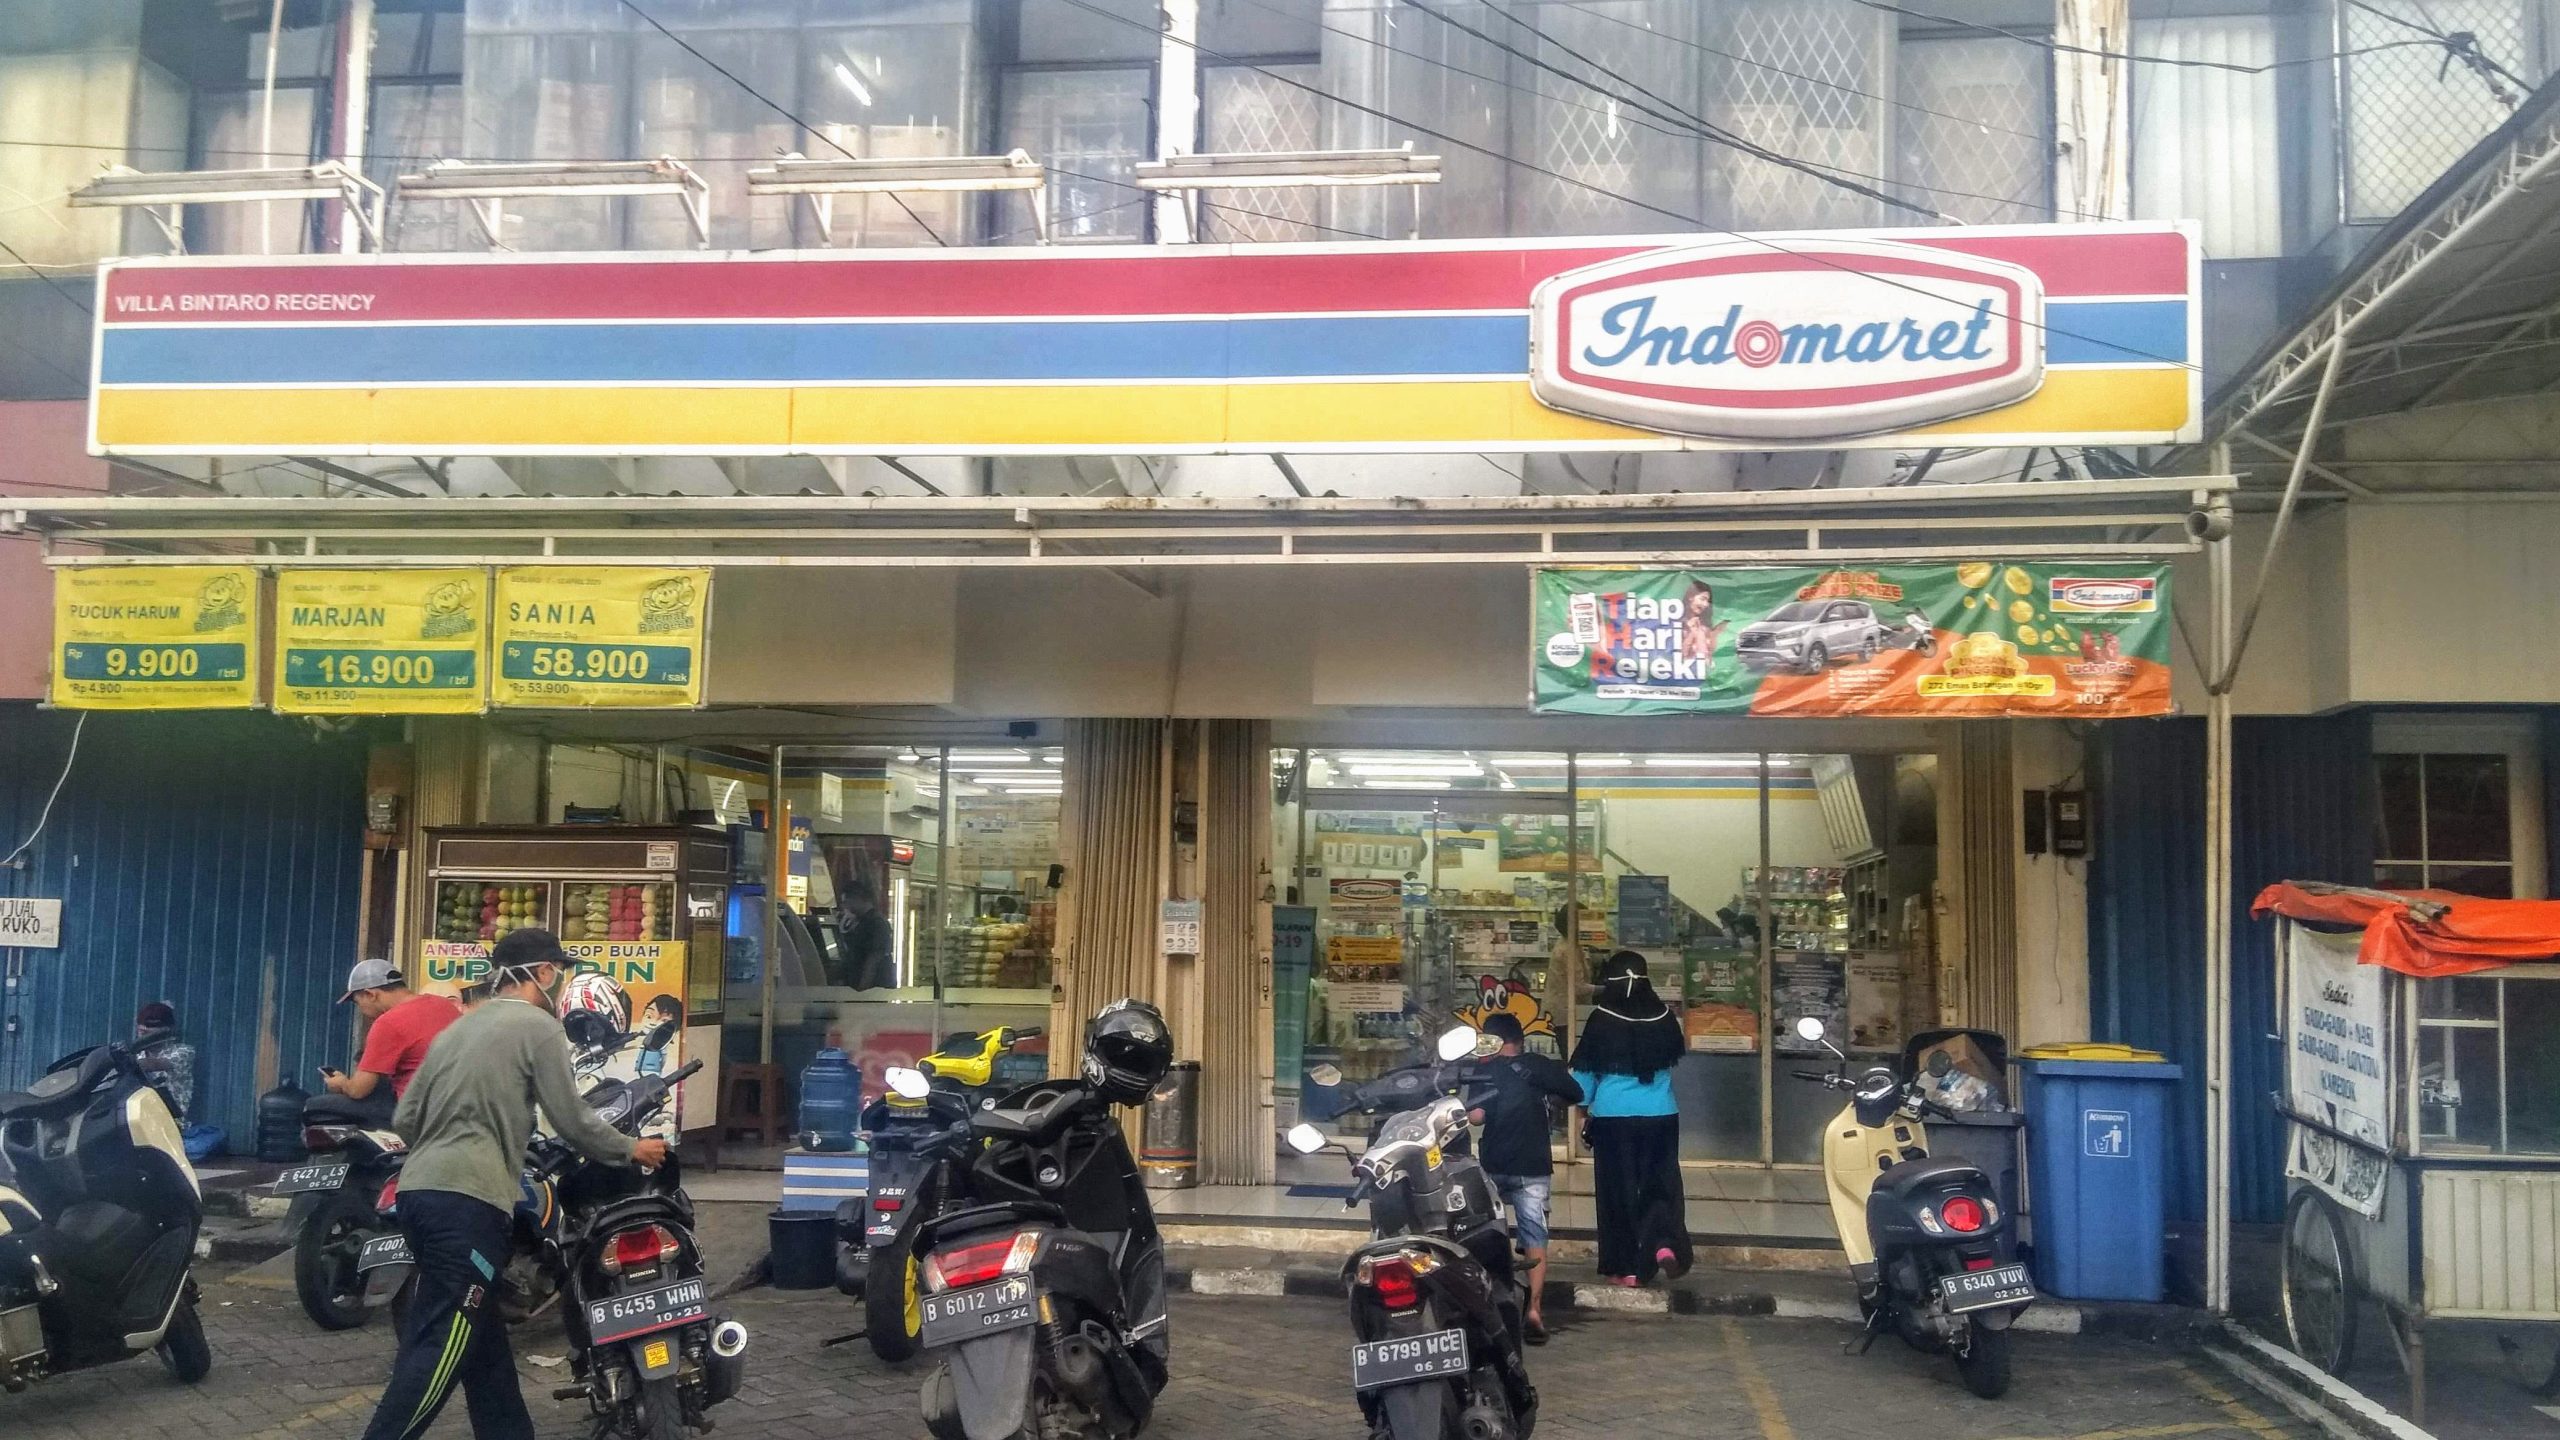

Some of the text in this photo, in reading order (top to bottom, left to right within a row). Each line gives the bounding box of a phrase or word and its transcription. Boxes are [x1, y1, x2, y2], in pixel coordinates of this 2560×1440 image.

[115, 293, 376, 312] VILLA BINTARO REGENCY
[1583, 296, 1995, 368] Indomaret
[70, 604, 123, 619] PUCUK
[128, 605, 180, 620] HARUM
[292, 607, 385, 627] MARJAN
[1601, 592, 1684, 626] Tiap
[1606, 618, 1683, 650] Hari
[68, 648, 83, 660] Rp
[106, 648, 198, 677] 9.900
[318, 655, 434, 684] 16.900
[532, 647, 649, 679] 58.900
[1590, 652, 1706, 683] Rejeki
[89, 683, 122, 694] 4.900
[528, 683, 570, 694] 53.900
[8, 900, 37, 918] JUAL
[2, 918, 41, 934] RUKO
[425, 943, 487, 957] ANEKA
[568, 945, 661, 957] SOP BUAH
[292, 1168, 320, 1181] 6421
[330, 1166, 346, 1177] LS
[1947, 1269, 2024, 1294] B 6340 VUV
[594, 1284, 701, 1323] B 6455 WHN
[927, 1303, 938, 1322] B
[946, 1292, 986, 1316] 6012
[1357, 1333, 1461, 1367] B 6799 WCE
[1415, 1357, 1462, 1373] 06 20
